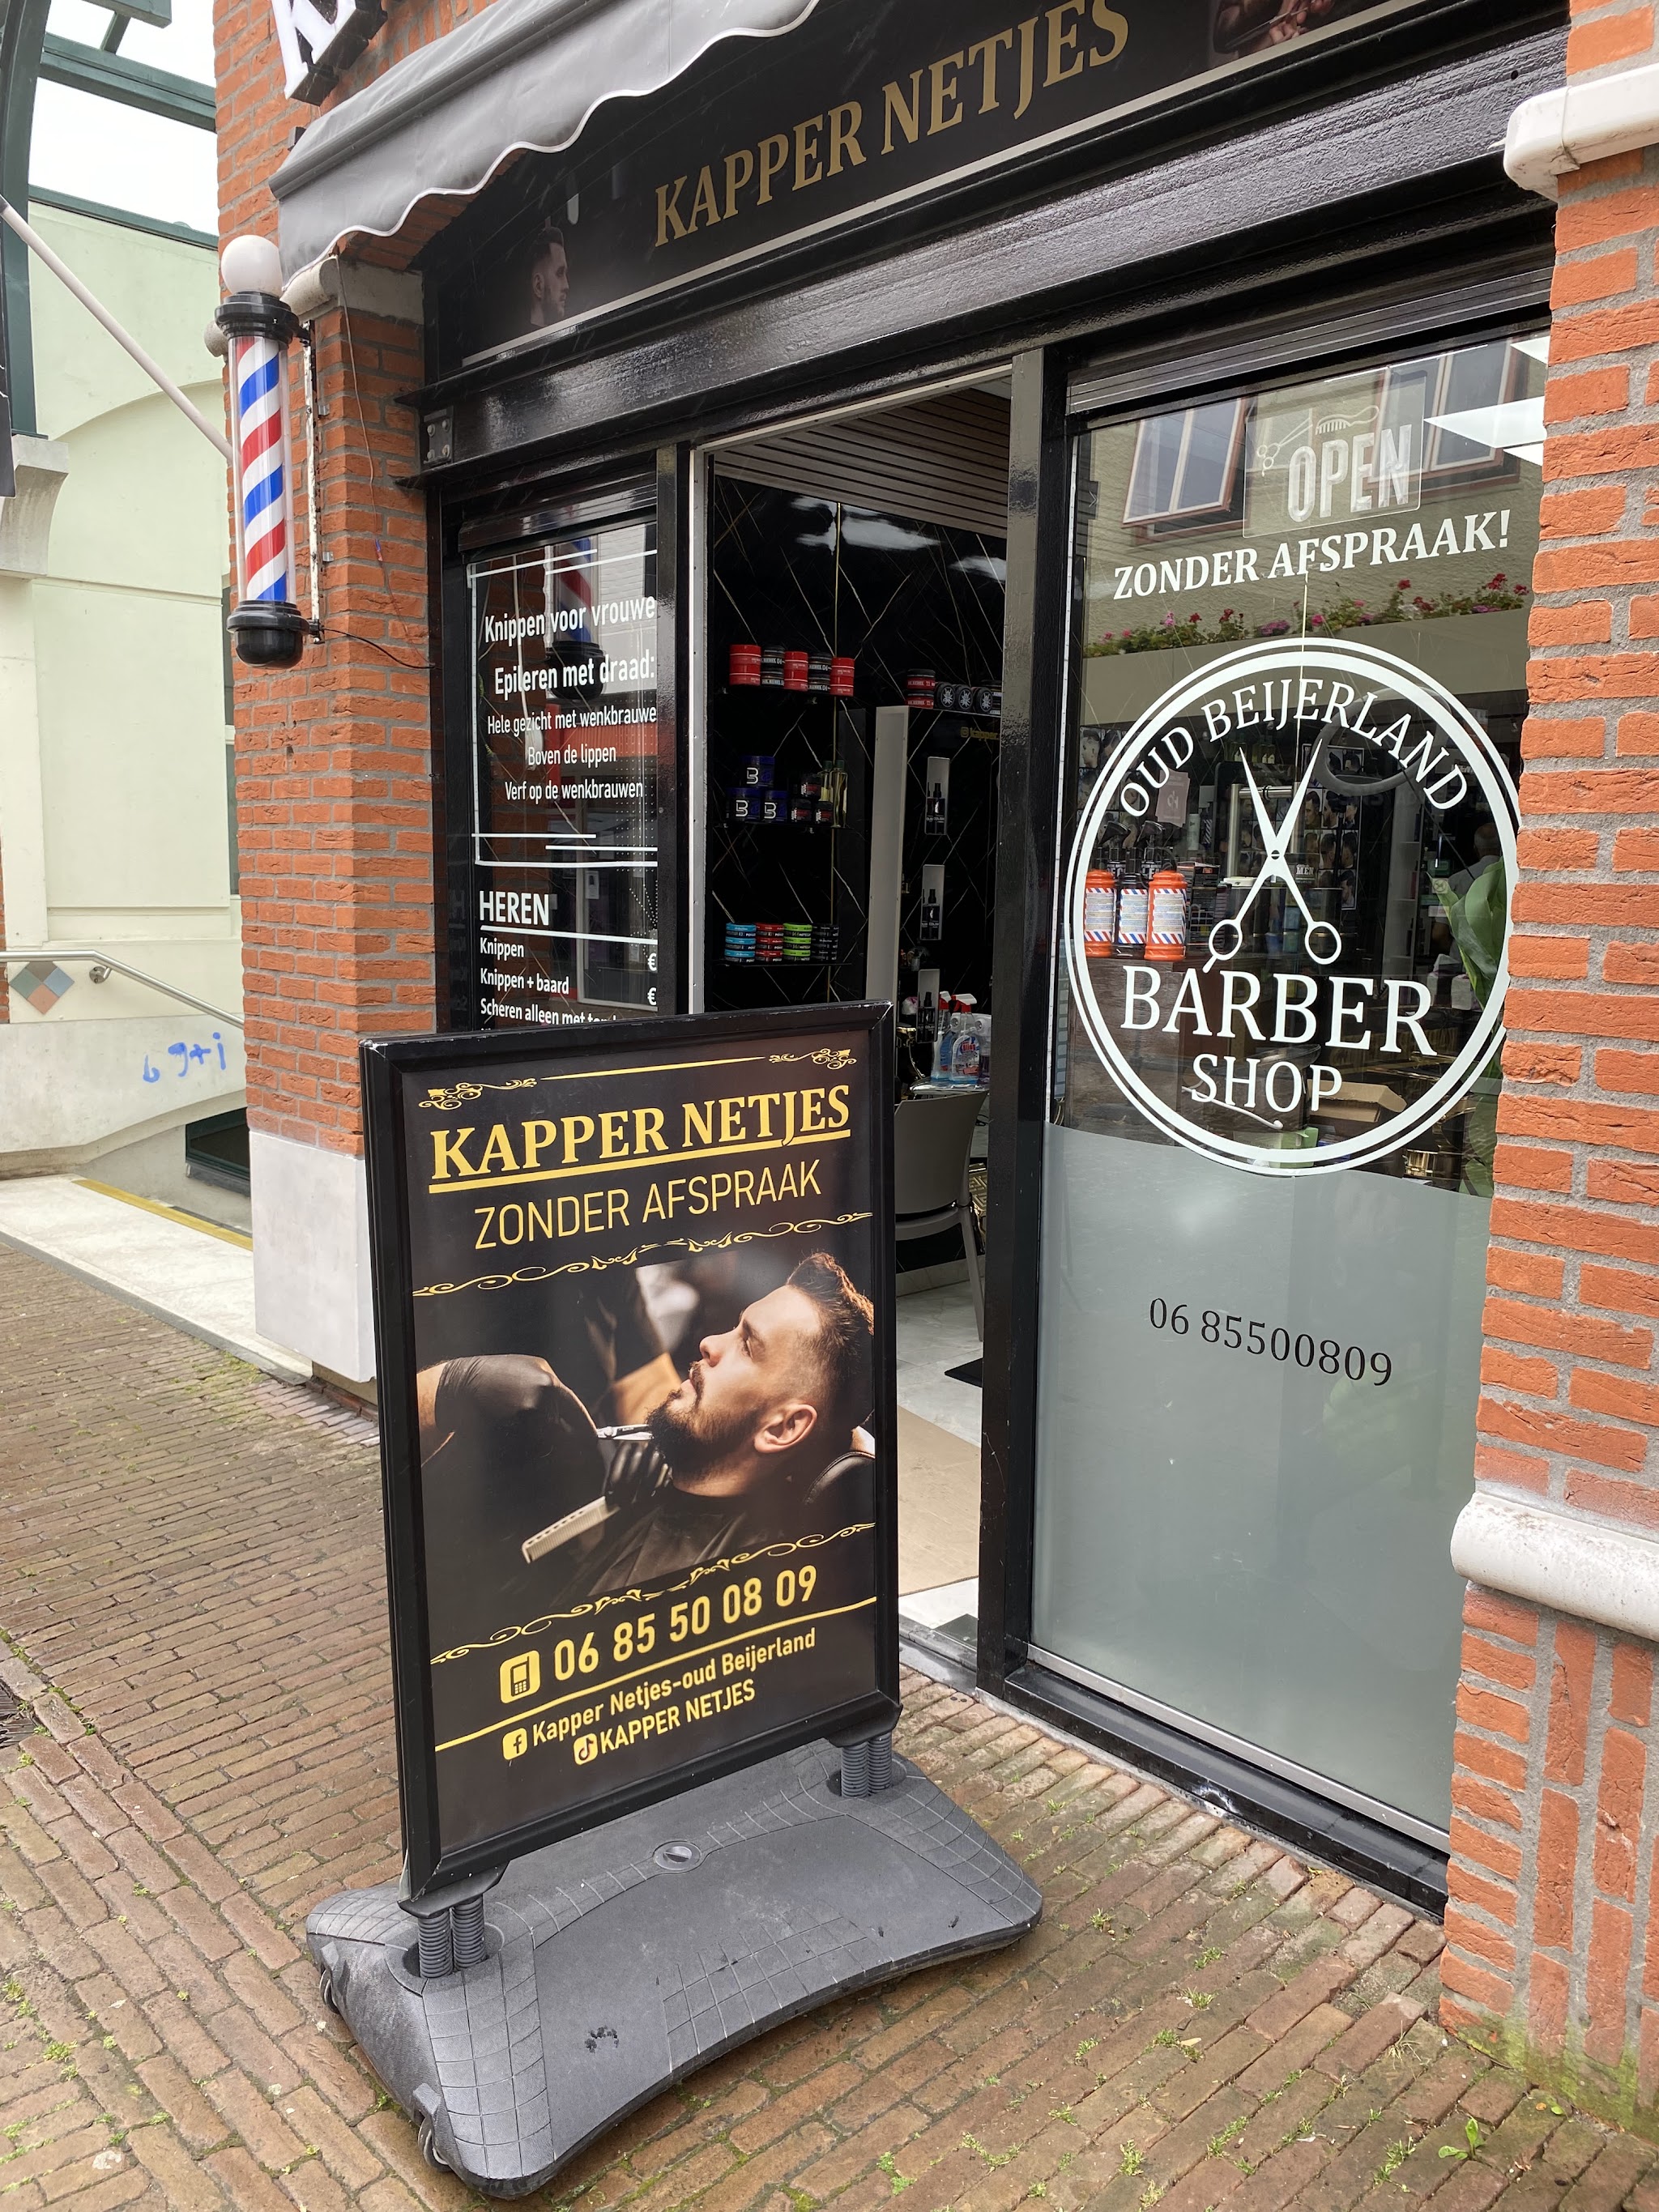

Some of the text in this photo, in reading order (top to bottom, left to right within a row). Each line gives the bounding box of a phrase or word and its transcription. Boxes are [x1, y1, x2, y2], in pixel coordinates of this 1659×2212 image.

[654, 0, 1130, 247] KAPPER NETJES
[1287, 424, 1412, 522] OPEN
[1113, 509, 1511, 600] ZONDER AFSPRAAK!
[484, 614, 545, 647] Knippen
[549, 607, 586, 633] voor
[494, 649, 655, 701] Epileren met draad:
[488, 714, 510, 735] Hele
[513, 710, 552, 738] gezicht
[555, 709, 577, 729] met
[528, 743, 617, 768] Boven de lippen
[1120, 678, 1467, 817] OUD BEIJERLAND
[505, 778, 644, 804] Verf op de wenkbrauwen
[479, 890, 549, 926] HEREN
[480, 937, 657, 971] Knippen €
[480, 968, 657, 1006] Knippen + baard €
[480, 998, 522, 1019] Scheren
[525, 1004, 559, 1025] alleen
[1120, 965, 1438, 1056] BARBER
[1191, 1054, 1342, 1114] SHOP
[430, 1085, 850, 1180] KAPPER NETJES
[475, 1159, 821, 1250] ZONDER AFSPRAAK
[1149, 1298, 1392, 1387] 06 85500809
[554, 1565, 817, 1681] 06 85 50 08 09
[532, 1628, 817, 1747] Kapper Netjes-oud Beijerland
[599, 1679, 756, 1754] KAPPER NETJES
